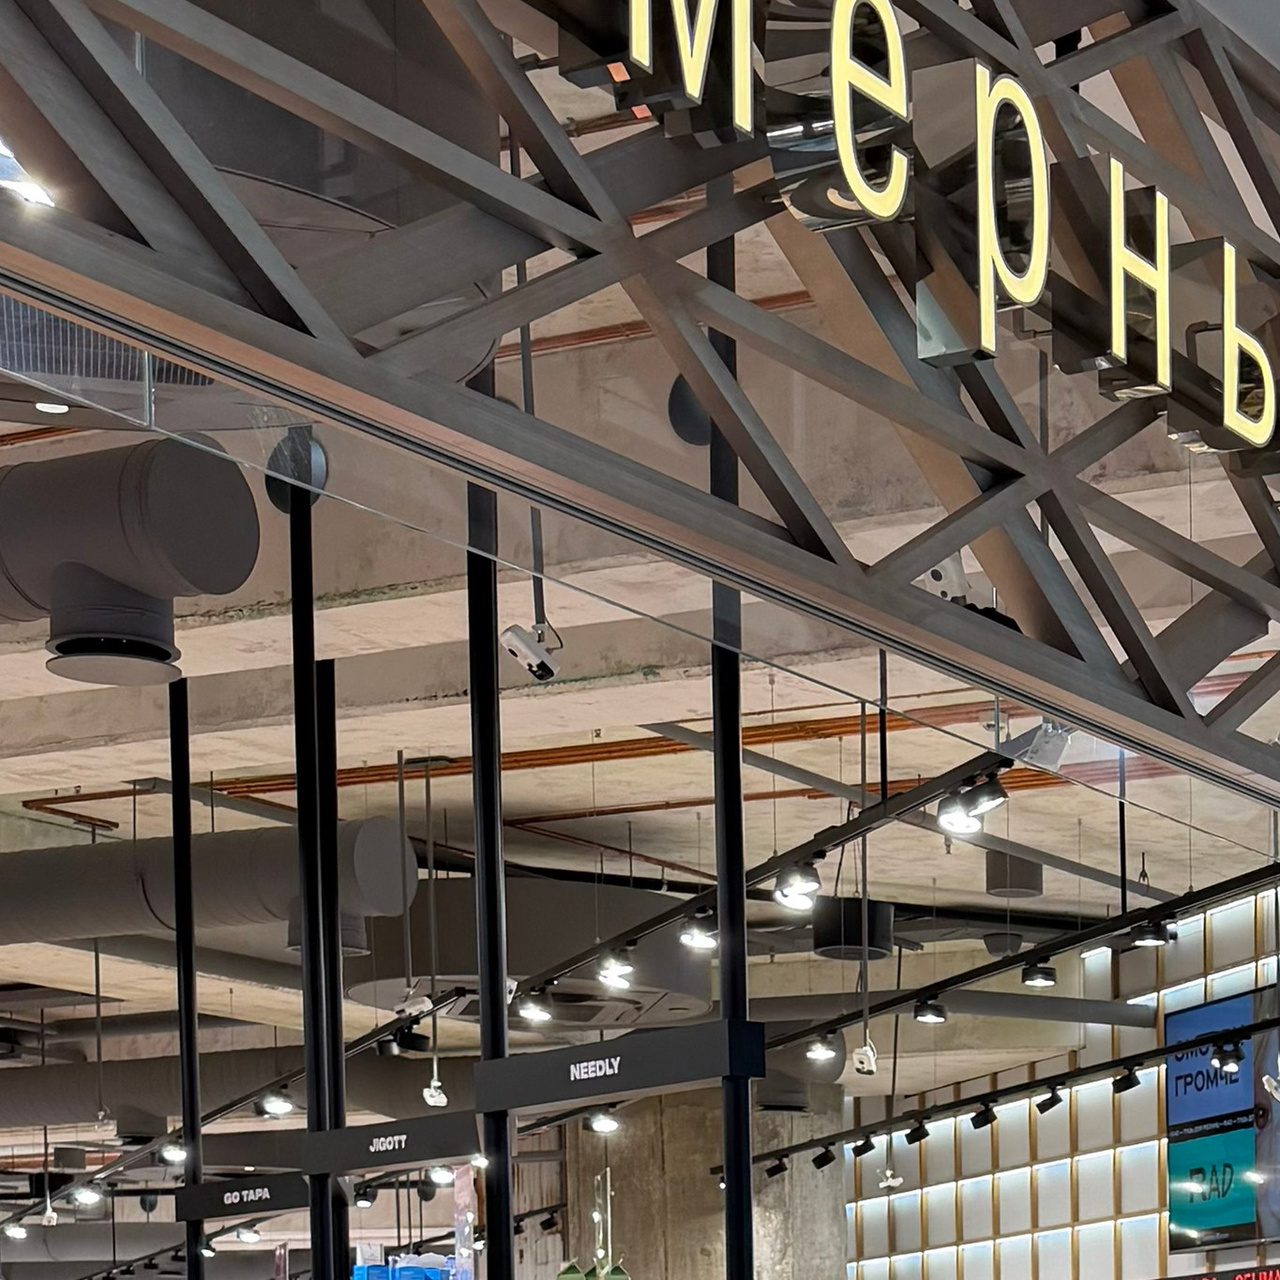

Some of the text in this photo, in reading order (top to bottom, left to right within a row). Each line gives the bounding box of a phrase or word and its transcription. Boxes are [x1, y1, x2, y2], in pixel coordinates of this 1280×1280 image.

[570, 1057, 621, 1080] NEEDLY
[369, 1134, 407, 1153] JIGOTT
[223, 1187, 270, 1204] GO TAPA
